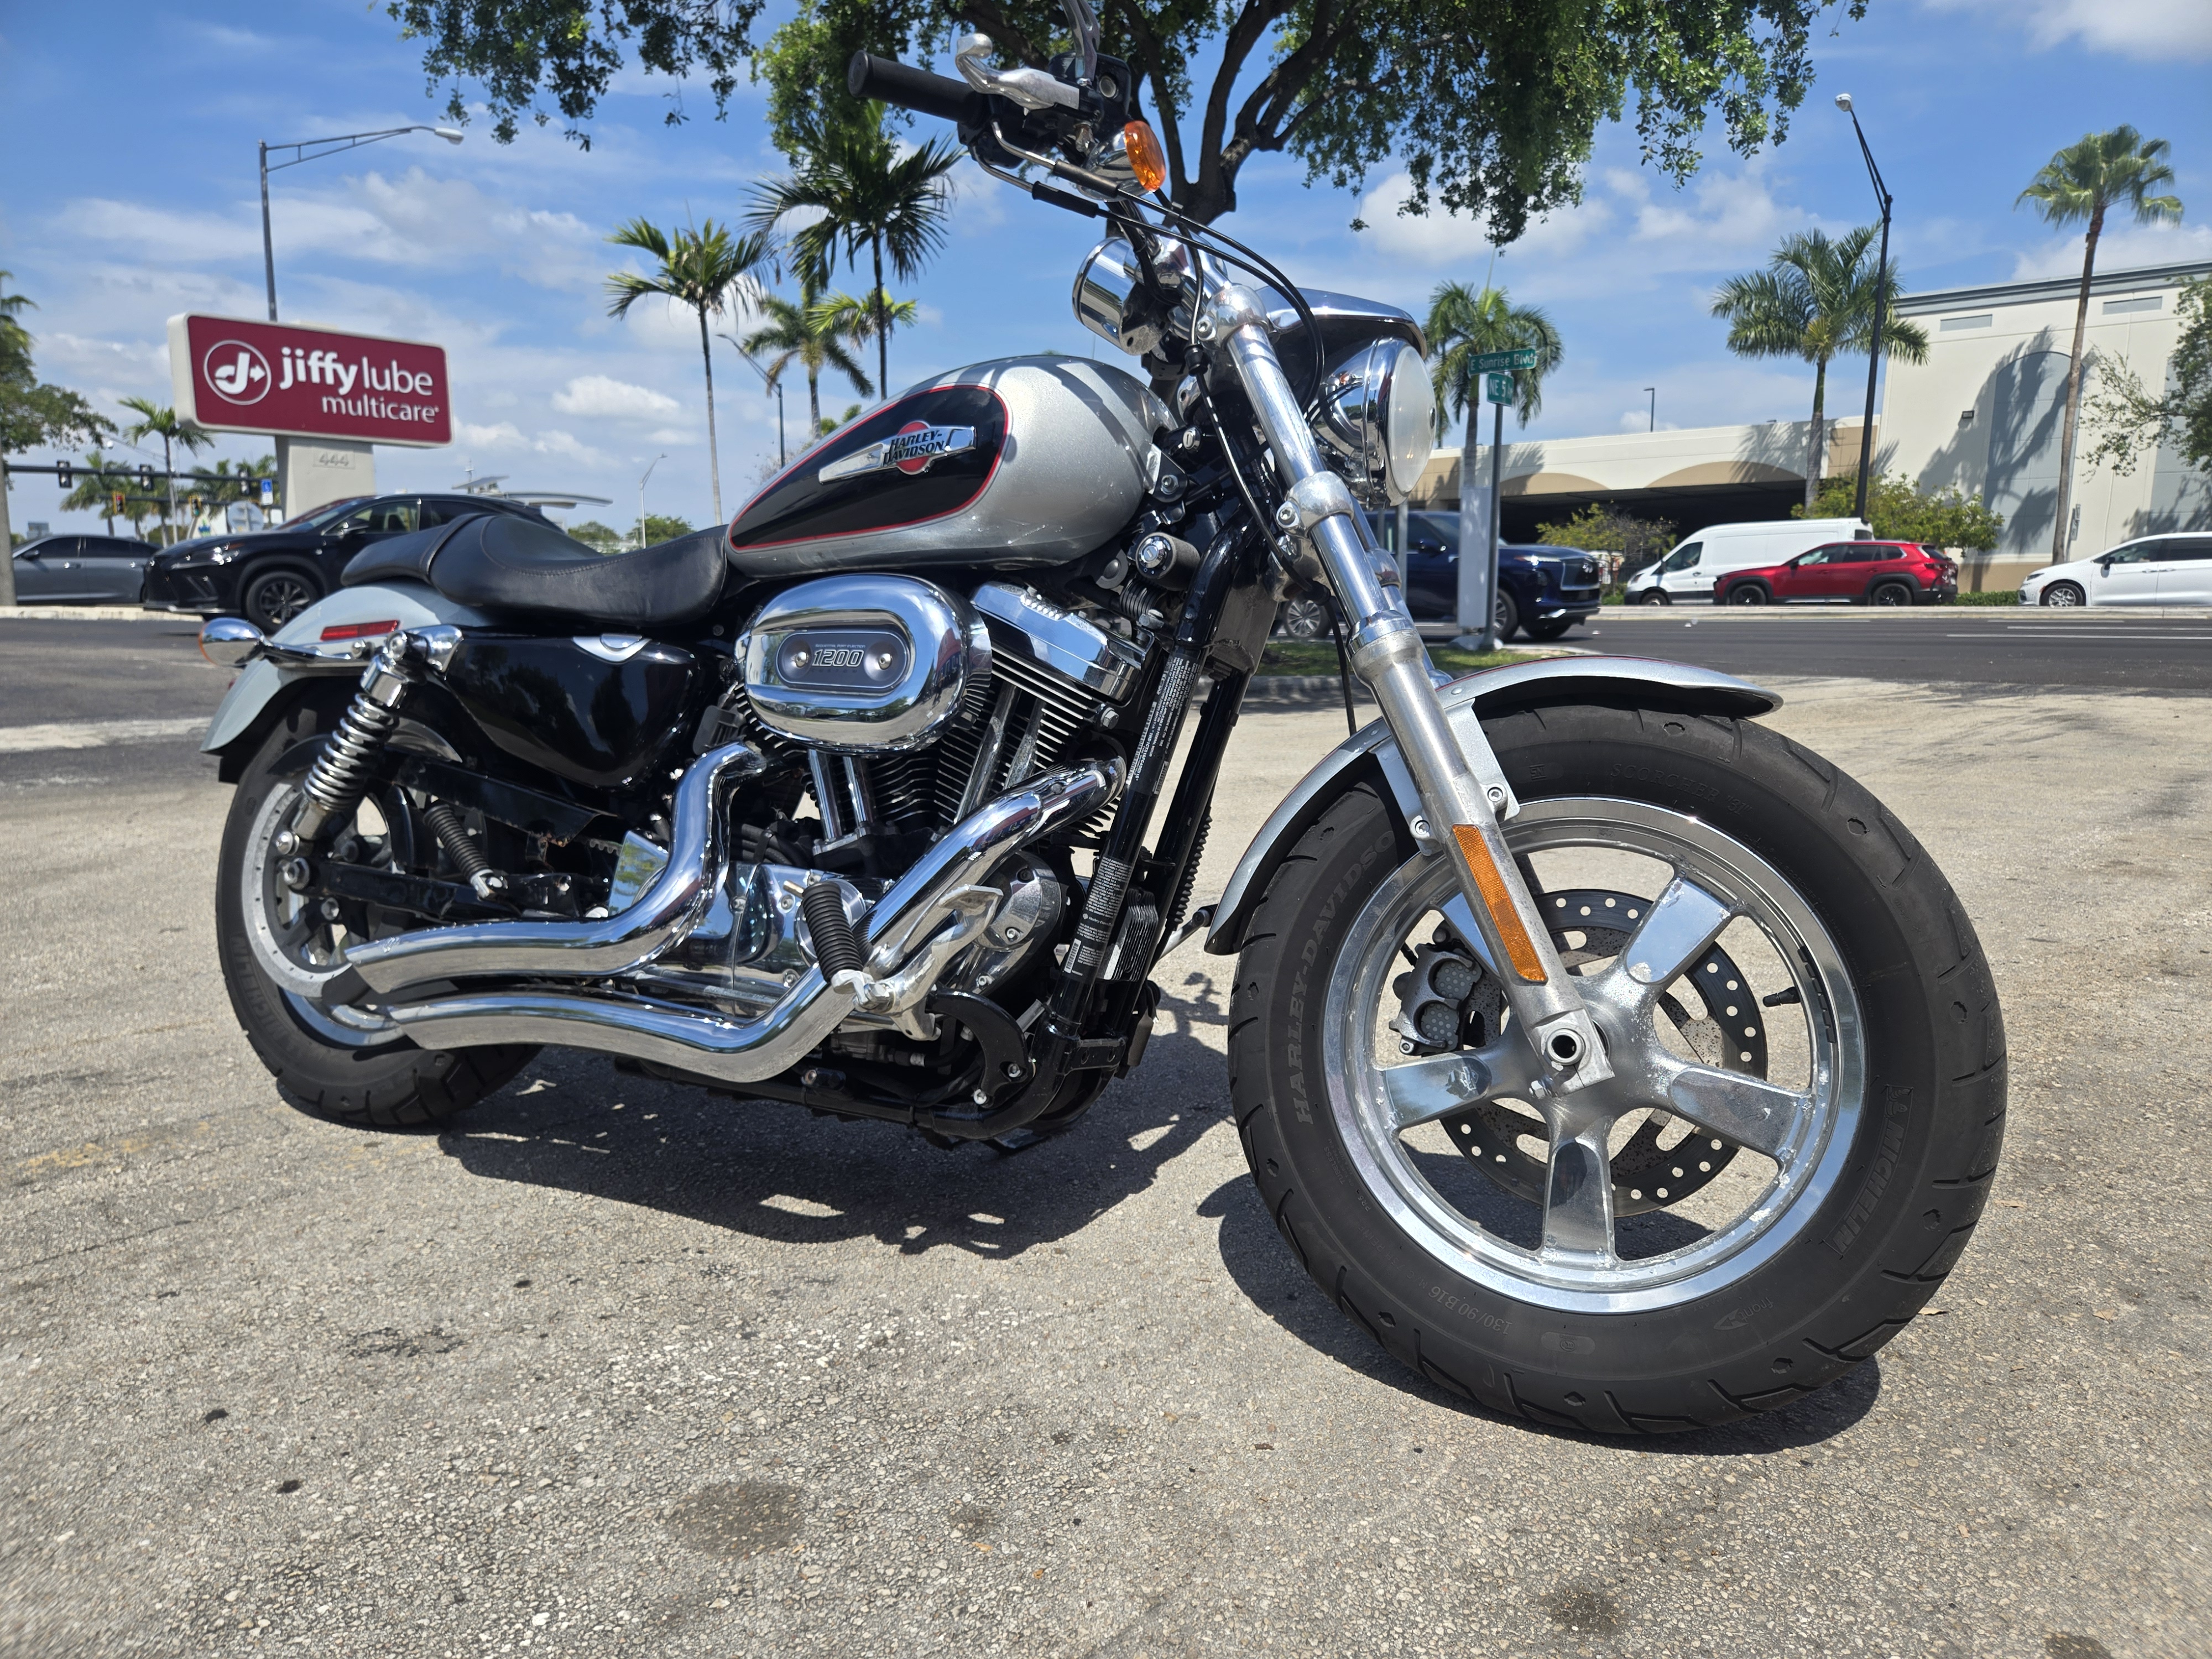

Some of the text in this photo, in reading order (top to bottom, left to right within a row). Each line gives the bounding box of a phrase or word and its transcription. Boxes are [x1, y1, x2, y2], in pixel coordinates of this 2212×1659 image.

[279, 347, 433, 397] jiffy lube
[1470, 353, 1534, 371] E Sunrise Blvd
[1489, 379, 1499, 397] NE
[883, 440, 945, 467] DAVIDSON
[812, 649, 864, 667] 1200
[1609, 761, 1723, 805] SCORCHER
[1323, 1146, 1345, 1185] TUBELESS
[1833, 1120, 1905, 1253] MICHELIN
[1404, 1268, 1430, 1290] M/C
[1425, 1282, 1462, 1312] B16
[1736, 1294, 1776, 1324] front
[1454, 1301, 1514, 1336] 130/90
